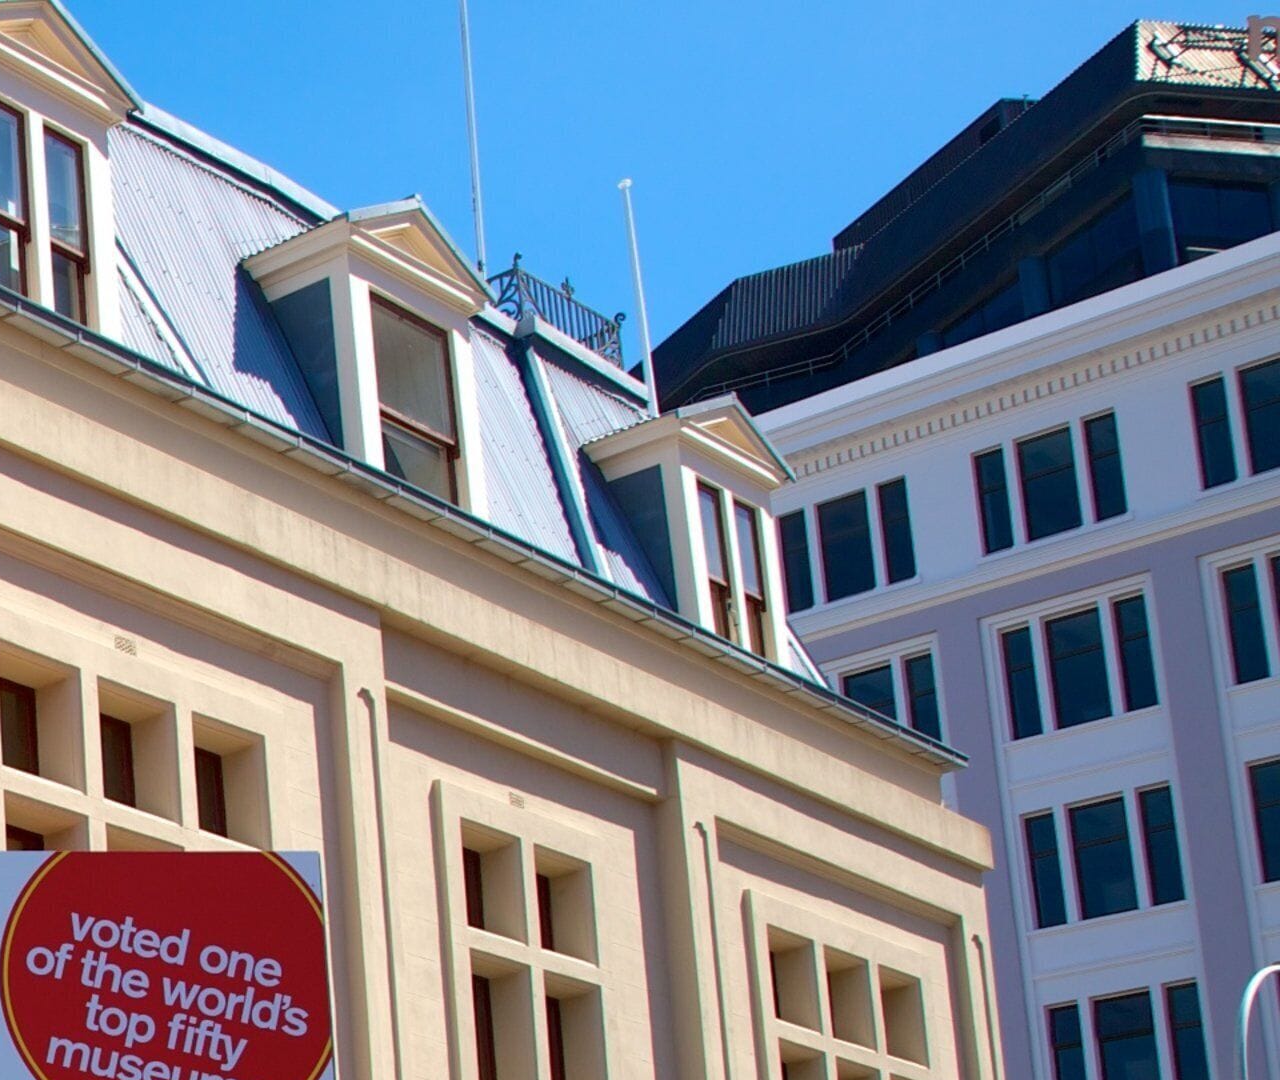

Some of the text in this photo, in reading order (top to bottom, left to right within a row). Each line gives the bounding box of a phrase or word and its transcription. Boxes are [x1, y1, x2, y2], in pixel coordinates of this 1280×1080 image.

[70, 911, 282, 988] voted one
[26, 943, 309, 1036] of the world’s
[86, 994, 248, 1072] top fifty
